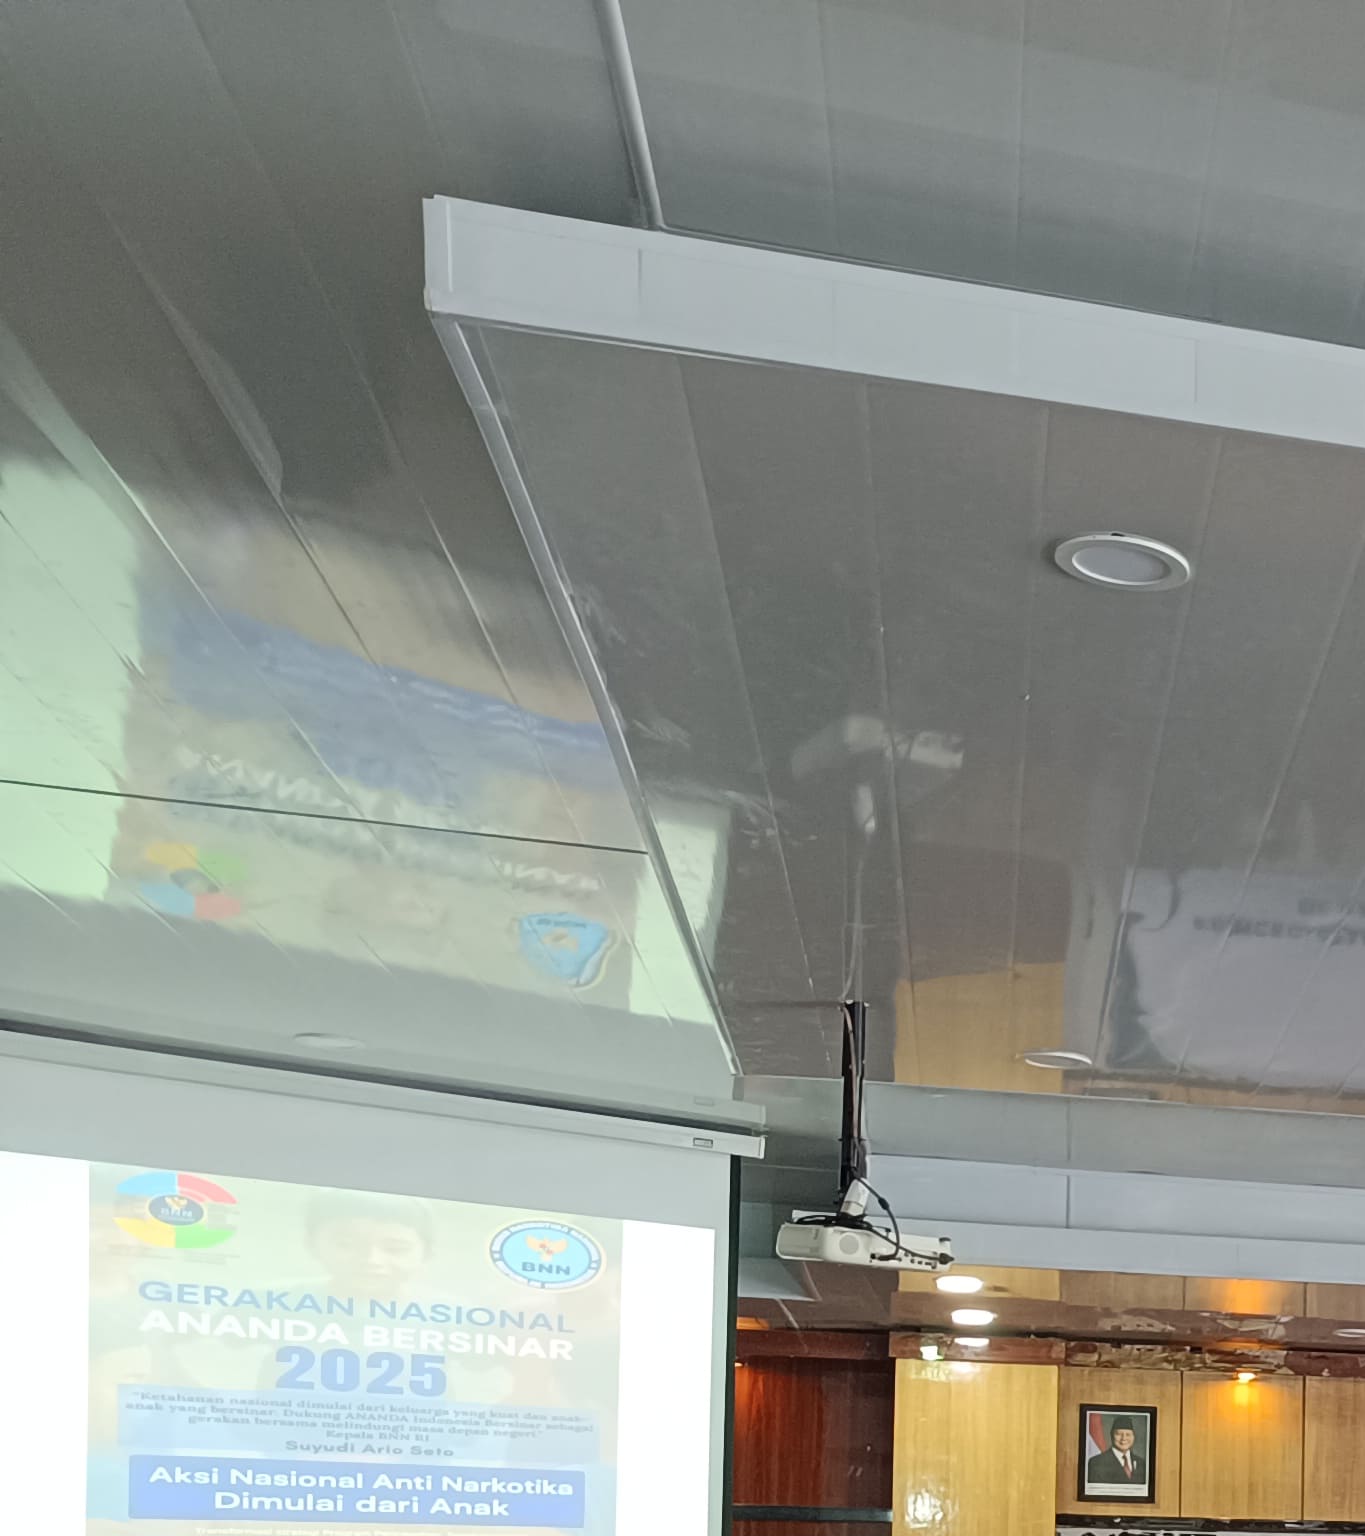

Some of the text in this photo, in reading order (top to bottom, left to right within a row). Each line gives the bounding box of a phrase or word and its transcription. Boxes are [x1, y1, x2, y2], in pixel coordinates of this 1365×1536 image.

[521, 1261, 571, 1276] BNN
[138, 1280, 576, 1333] GERAKAN NASIONAL
[138, 1308, 575, 1361] ANANDA BERSINAR
[274, 1345, 448, 1398] 2025
[285, 1440, 355, 1455] Suyudi
[361, 1443, 404, 1455] Ario
[148, 1465, 574, 1497] Aksi Nasional Anti Narkotika
[213, 1492, 510, 1517] Dimulai dari Anak
